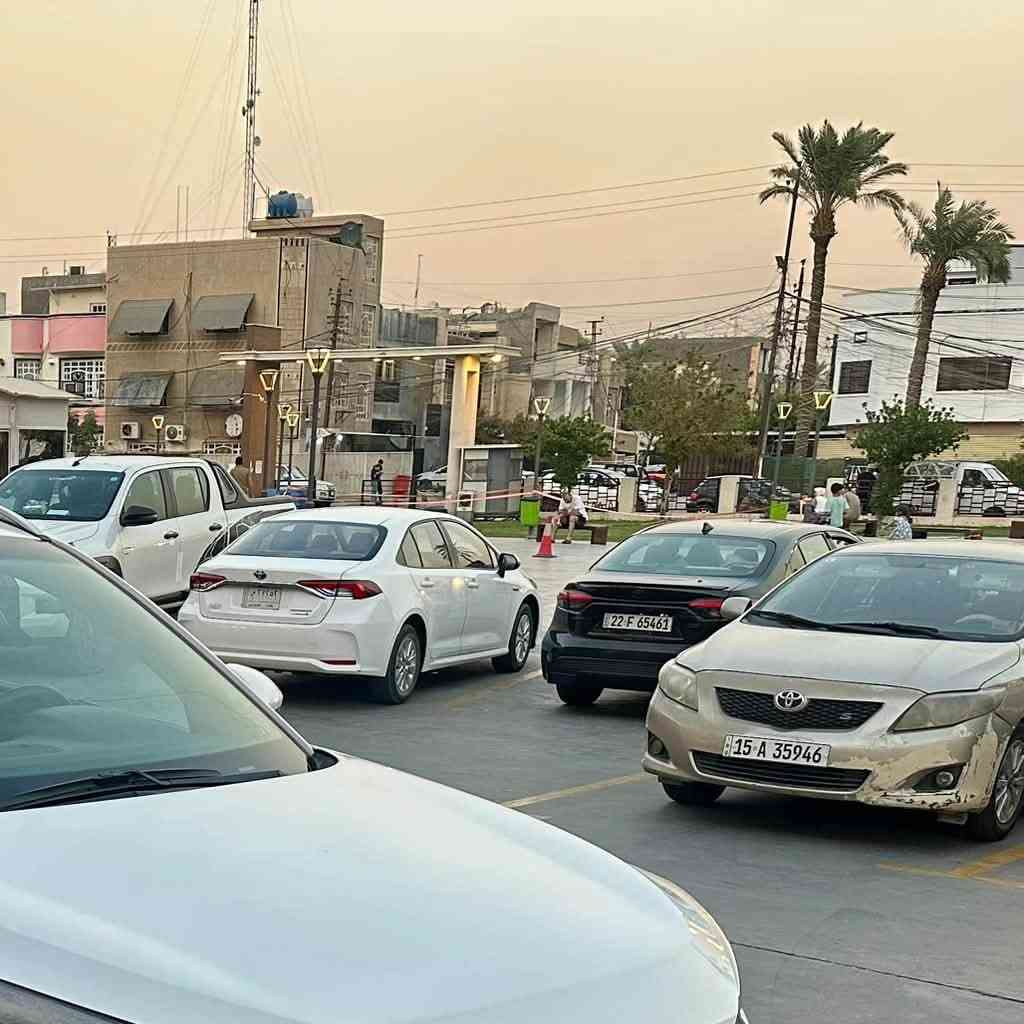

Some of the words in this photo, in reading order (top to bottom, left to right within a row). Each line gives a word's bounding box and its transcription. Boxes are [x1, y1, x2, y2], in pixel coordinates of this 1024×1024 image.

[611, 615, 624, 627] 22
[627, 616, 634, 627] F
[637, 616, 669, 630] 65461
[733, 739, 753, 756] 15
[757, 741, 766, 758] A
[773, 742, 822, 763] 35946
